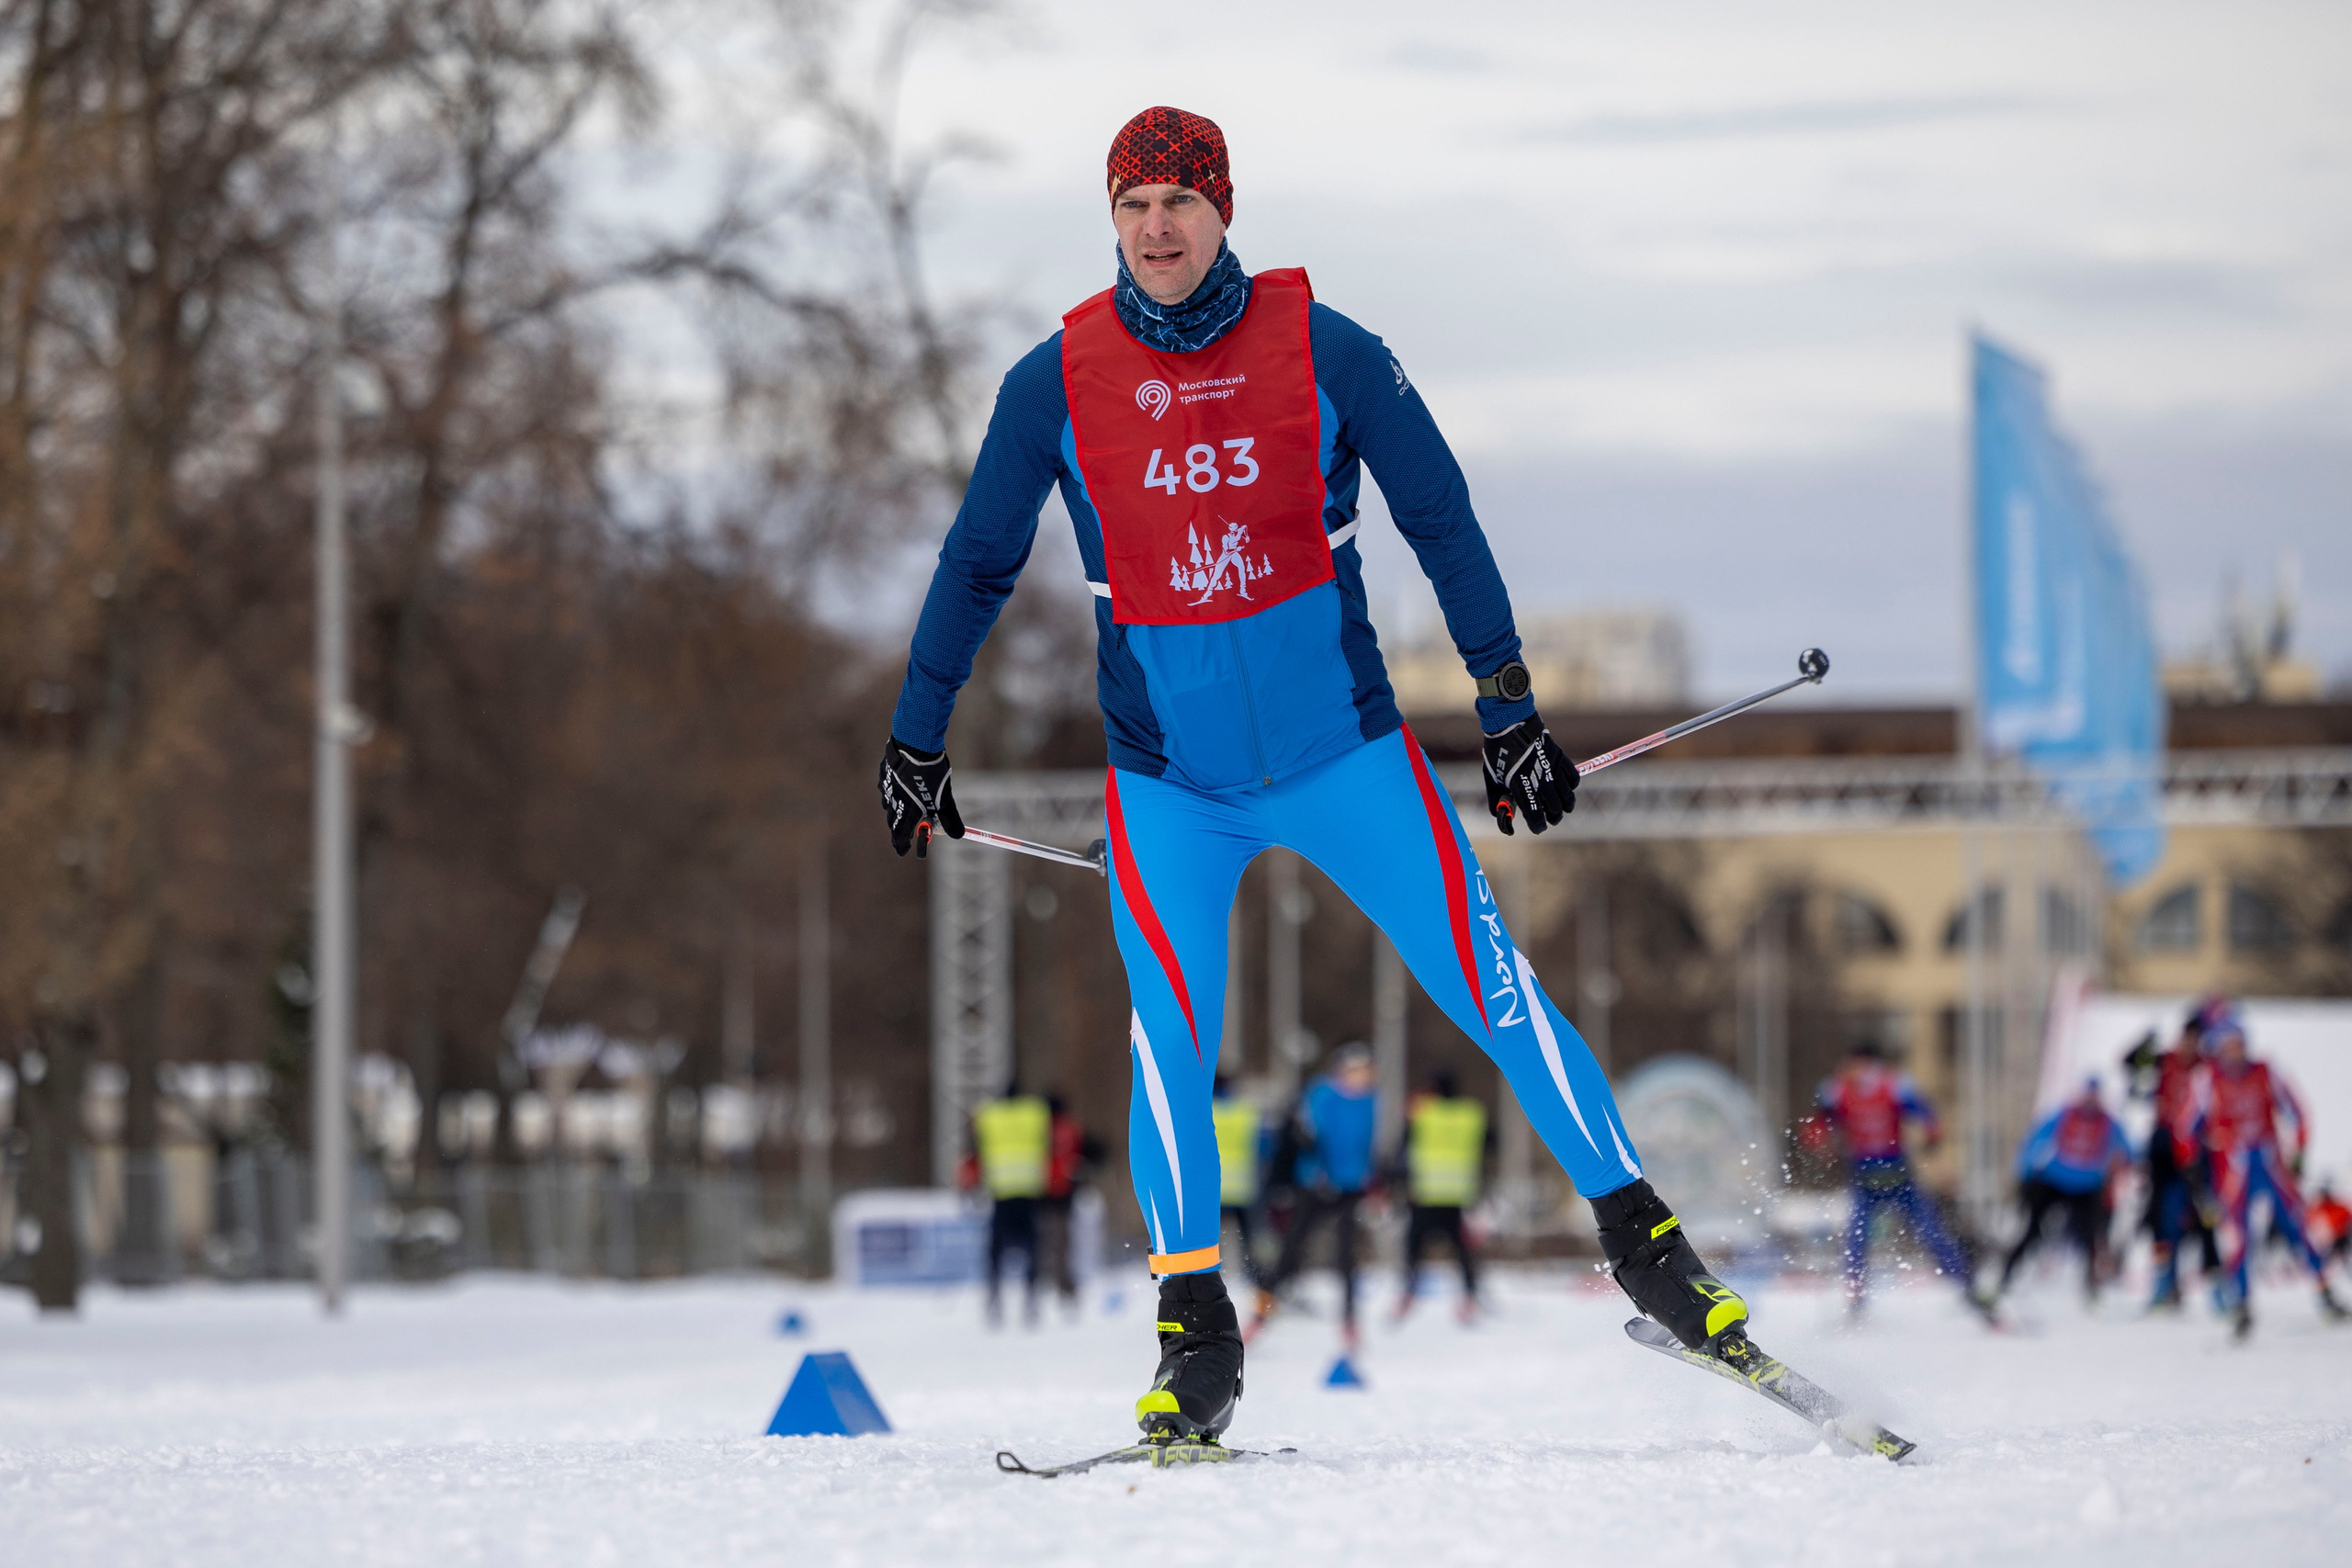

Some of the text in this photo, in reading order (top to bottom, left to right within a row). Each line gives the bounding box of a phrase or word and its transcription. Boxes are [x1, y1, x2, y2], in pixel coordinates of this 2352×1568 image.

[1178, 374, 1246, 392] Московский
[1179, 389, 1236, 405] транспорт
[1144, 436, 1260, 496] 483
[1533, 737, 1555, 783] ziene
[913, 775, 936, 810] LEKI
